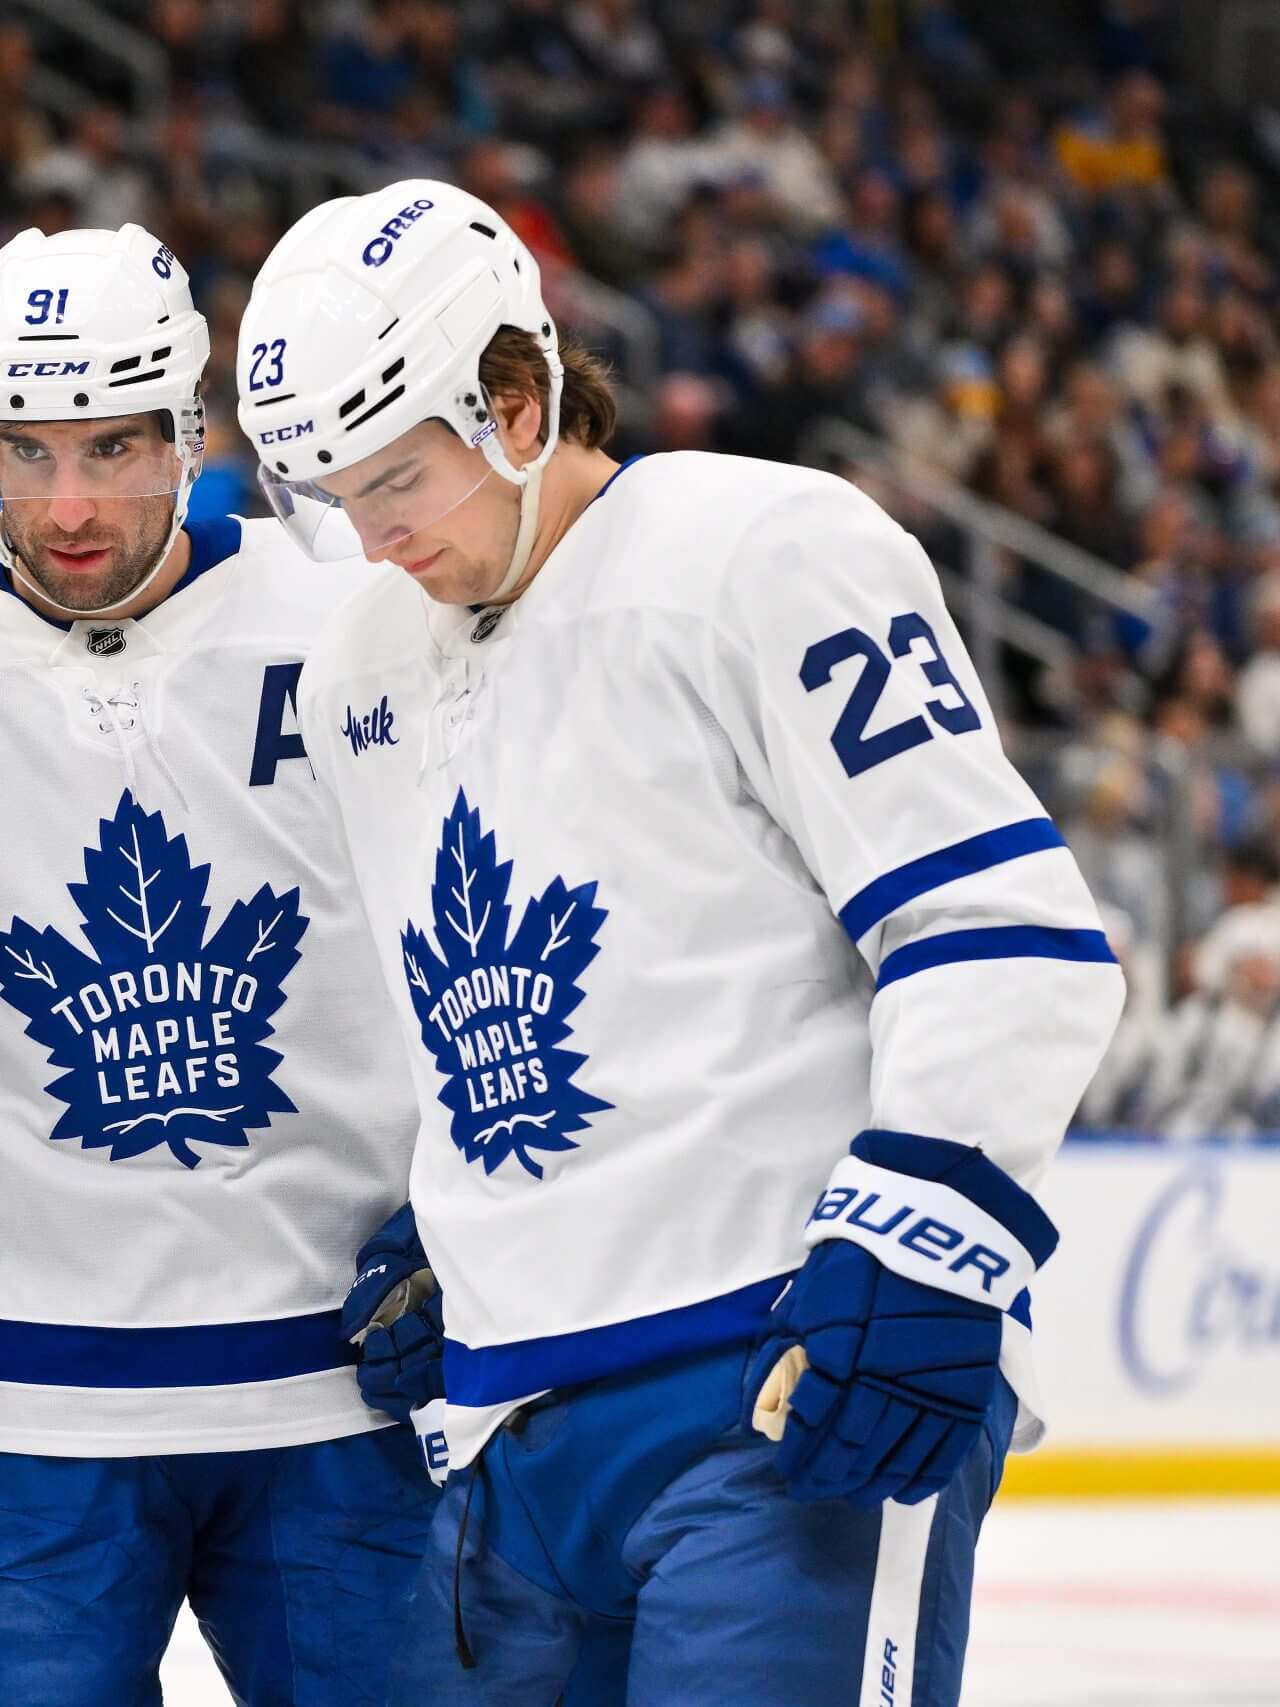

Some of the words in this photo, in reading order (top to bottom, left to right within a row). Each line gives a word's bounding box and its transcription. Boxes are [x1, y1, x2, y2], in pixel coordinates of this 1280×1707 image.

[362, 199, 435, 268] OREO
[24, 288, 69, 325] 91
[7, 361, 90, 377] CCM
[249, 338, 287, 392] 23
[259, 420, 315, 445] CCM
[95, 634, 119, 652] NHL
[799, 612, 982, 778] 23
[249, 662, 312, 788] A
[50, 962, 258, 1035] TORONTO
[428, 965, 554, 1042] TORONTO
[91, 1010, 236, 1064] MAPLE
[455, 1014, 539, 1070] MAPLE
[97, 1053, 240, 1104] LEAFS
[466, 1057, 548, 1113] LEAFS
[805, 1187, 1010, 1293] AUER
